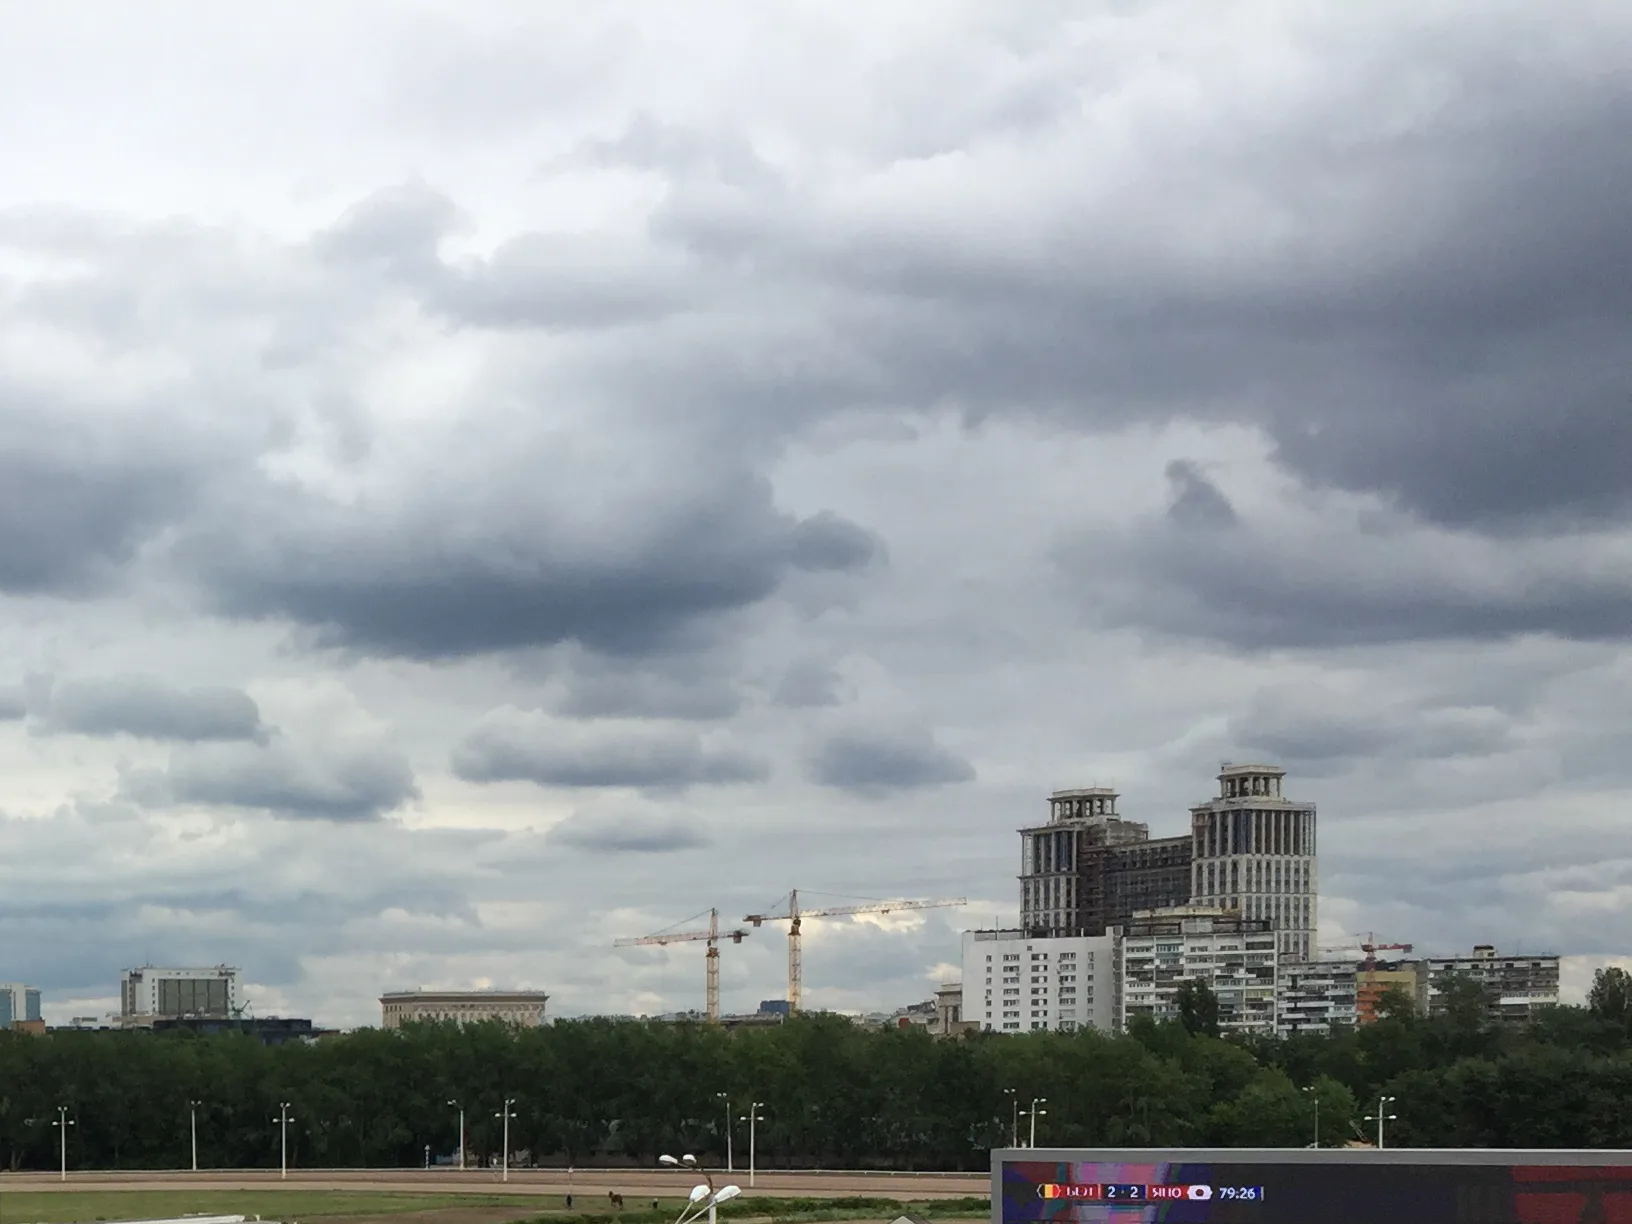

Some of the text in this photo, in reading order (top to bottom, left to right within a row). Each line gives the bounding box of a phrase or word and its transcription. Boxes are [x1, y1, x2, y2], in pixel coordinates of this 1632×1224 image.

[1107, 1186, 1116, 1197] 2
[1130, 1186, 1139, 1197] 2
[1219, 1187, 1256, 1199] 79:26
